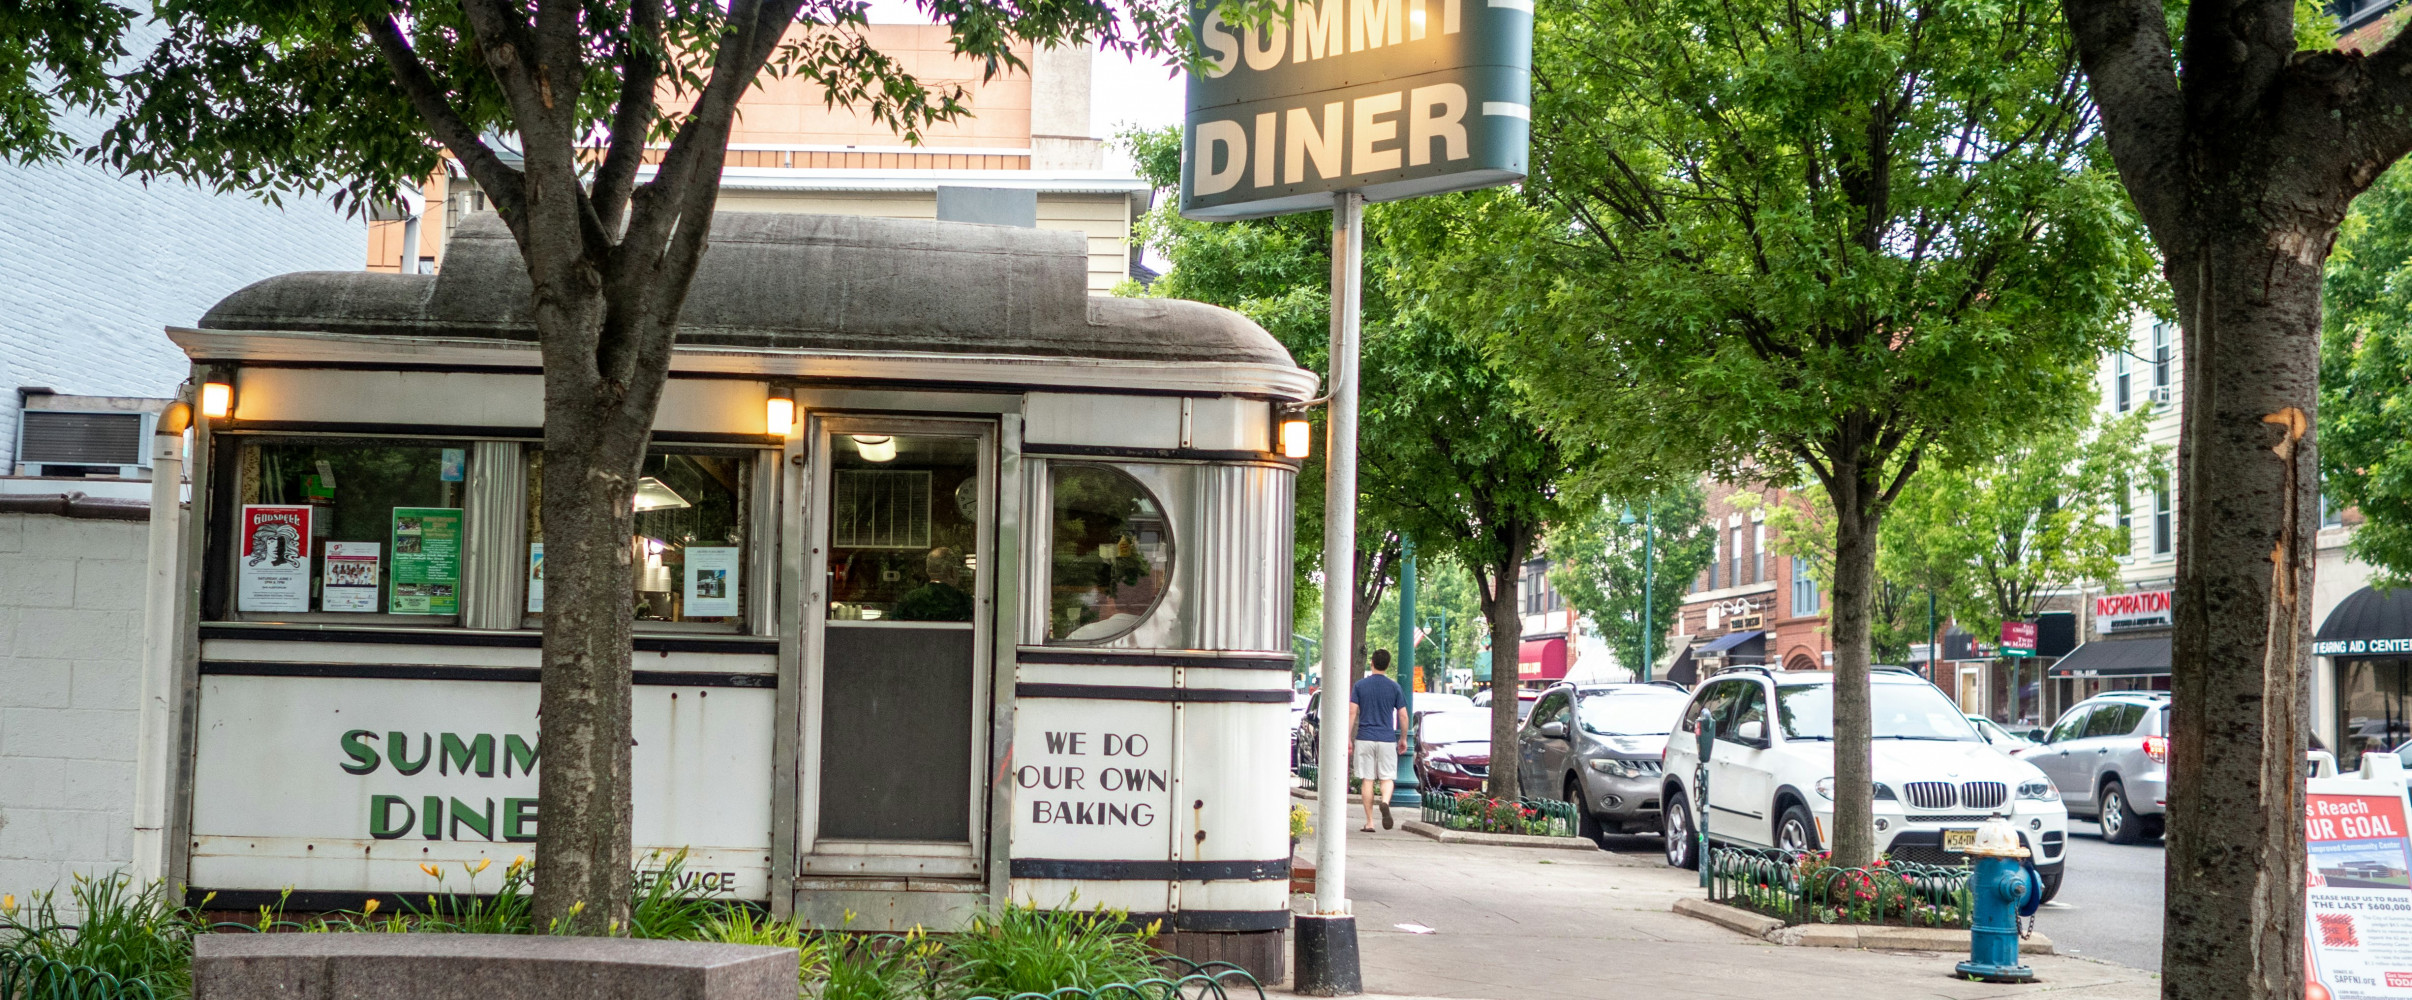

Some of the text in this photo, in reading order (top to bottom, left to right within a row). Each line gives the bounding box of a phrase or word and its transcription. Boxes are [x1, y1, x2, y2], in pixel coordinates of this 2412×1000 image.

[1194, 83, 1469, 197] DINER
[254, 513, 300, 526] GODSPELL
[2097, 592, 2170, 616] INSPIRATION
[2349, 640, 2366, 652] AID
[339, 729, 541, 778] SUMM
[1045, 731, 1148, 757] WE DO
[1018, 765, 1166, 792] OUR OWN
[369, 795, 538, 842] DINE
[1033, 800, 1154, 827] BAKING
[2317, 799, 2369, 816] Reach
[2306, 815, 2398, 840] UR GOAL
[632, 870, 735, 892] EVICE
[2312, 901, 2411, 911] THE LAST $600,000
[2388, 978, 2412, 986] TOD
